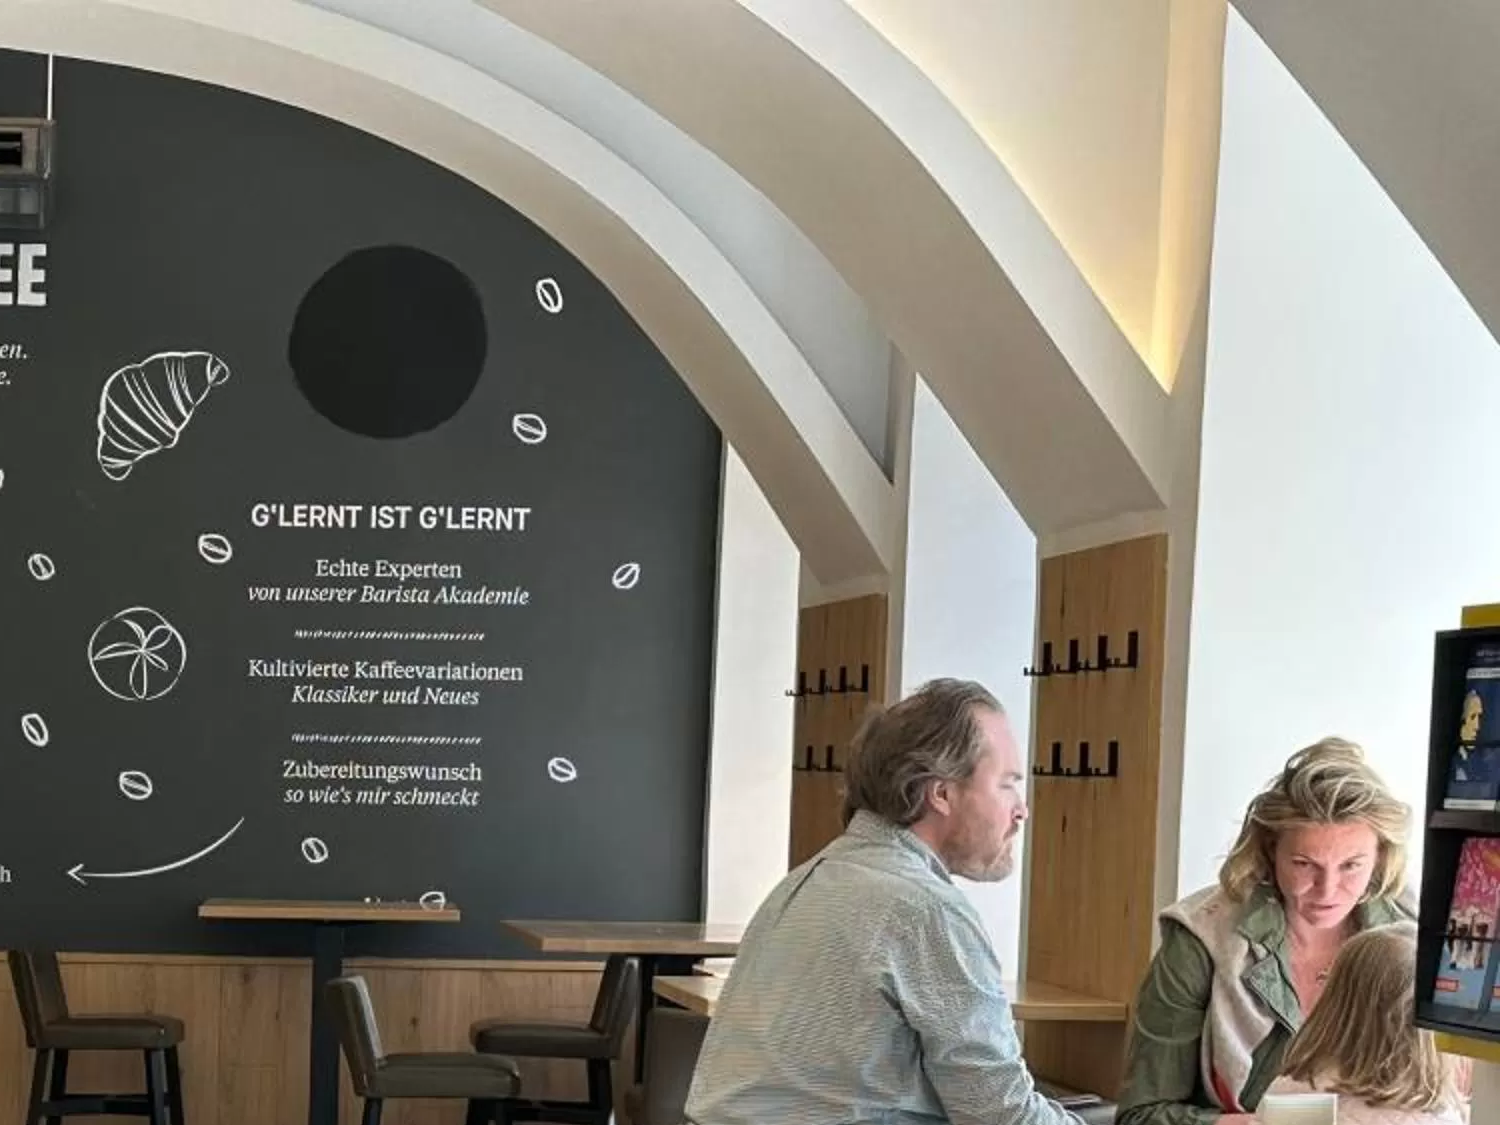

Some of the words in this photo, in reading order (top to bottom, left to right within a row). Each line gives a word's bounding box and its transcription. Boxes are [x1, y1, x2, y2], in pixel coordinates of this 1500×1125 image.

[251, 504, 361, 528] G'LERNT
[371, 506, 411, 529] IST
[419, 506, 531, 530] G'LERNT
[316, 560, 369, 577] Echte
[375, 560, 462, 581] Experten
[248, 586, 280, 602] von
[286, 587, 356, 602] unserer
[360, 586, 429, 603] Barista
[434, 587, 530, 605] Akademie
[249, 660, 349, 678] Kultivierte
[354, 661, 523, 681] Kaffeevariationen
[292, 686, 378, 704] Klassiker
[383, 687, 420, 705] und
[423, 688, 479, 705] Neues
[283, 760, 482, 783] Zubereitungswunsch
[284, 788, 303, 803] so
[309, 787, 351, 804] wie's
[355, 789, 390, 804] mir
[393, 789, 480, 806] schmeckt
